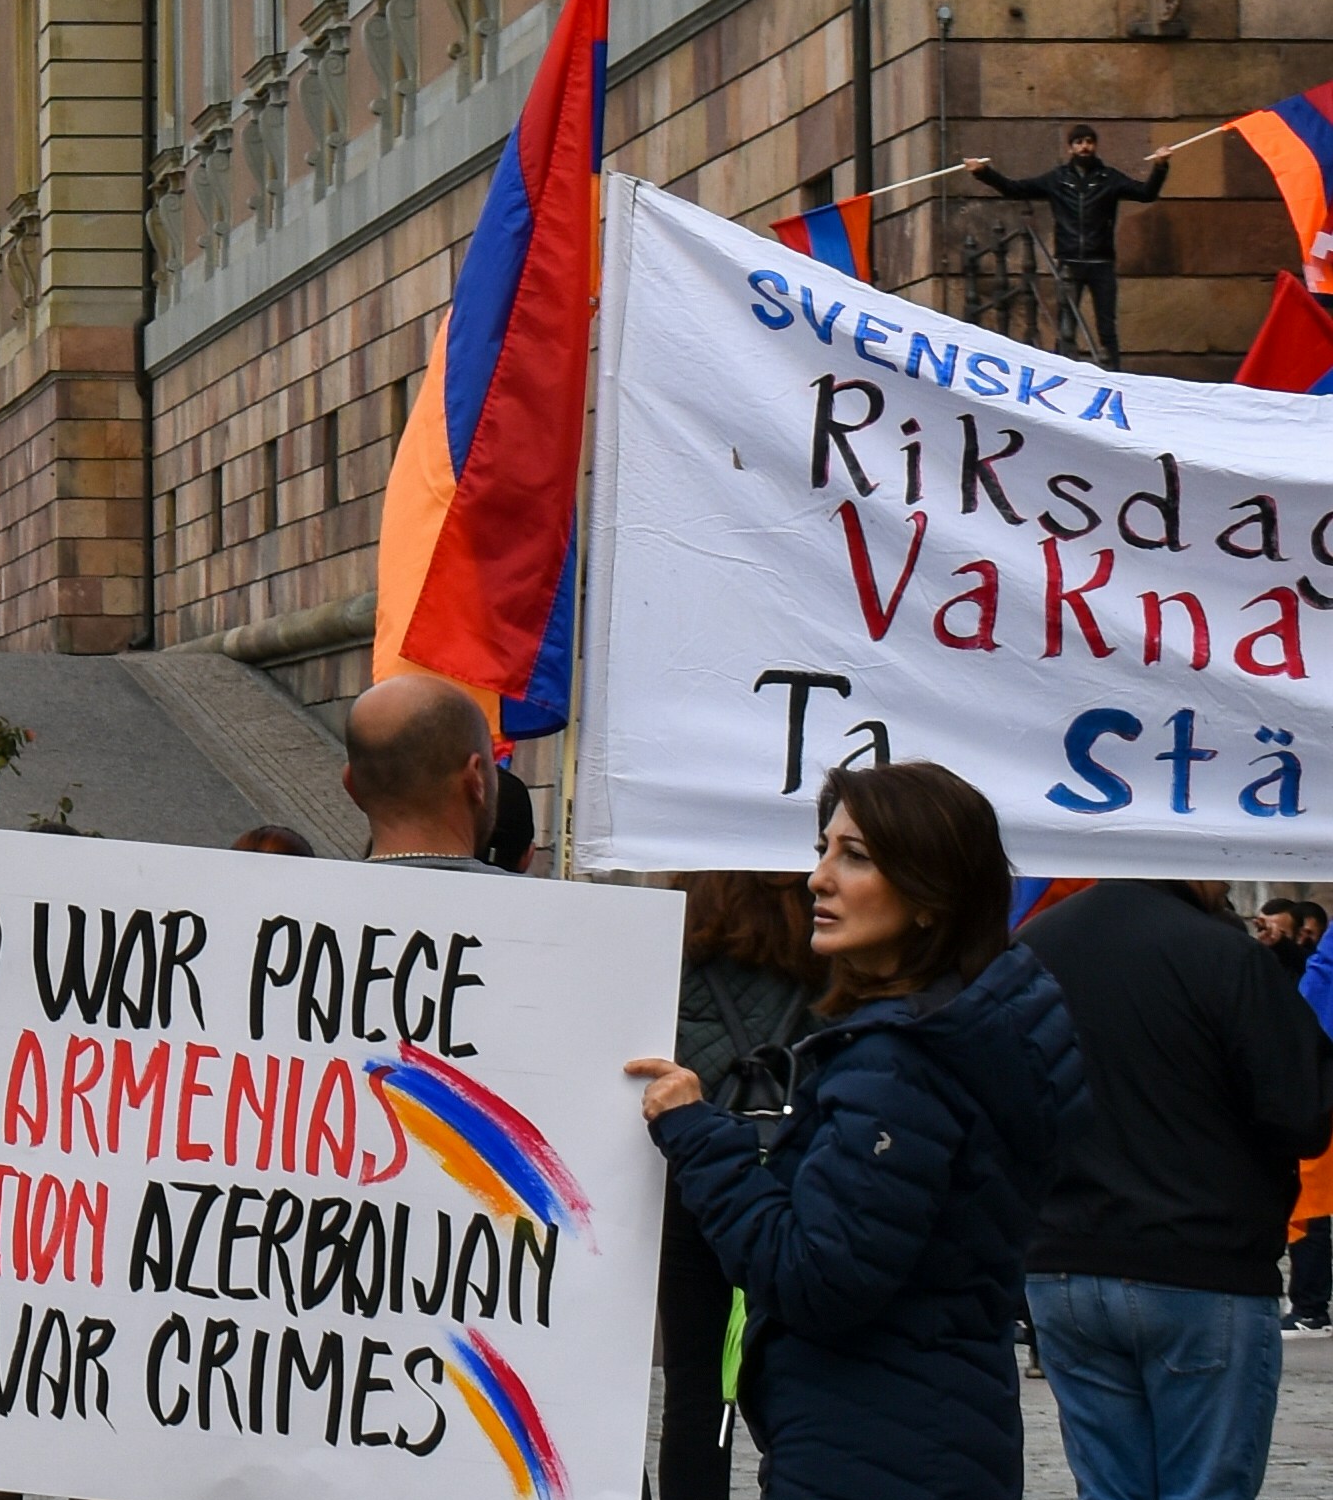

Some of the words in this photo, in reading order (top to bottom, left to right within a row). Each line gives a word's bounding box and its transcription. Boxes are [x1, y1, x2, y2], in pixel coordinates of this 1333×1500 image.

[747, 269, 1131, 430] SVENSKA
[1046, 708, 1307, 817] Stä
[32, 902, 207, 1031] WAR
[249, 915, 485, 1058] PAECE
[4, 1028, 408, 1185] ARMENIAS
[129, 1180, 559, 1326] AZERBAIJAN
[147, 1313, 446, 1457] CRIMES
